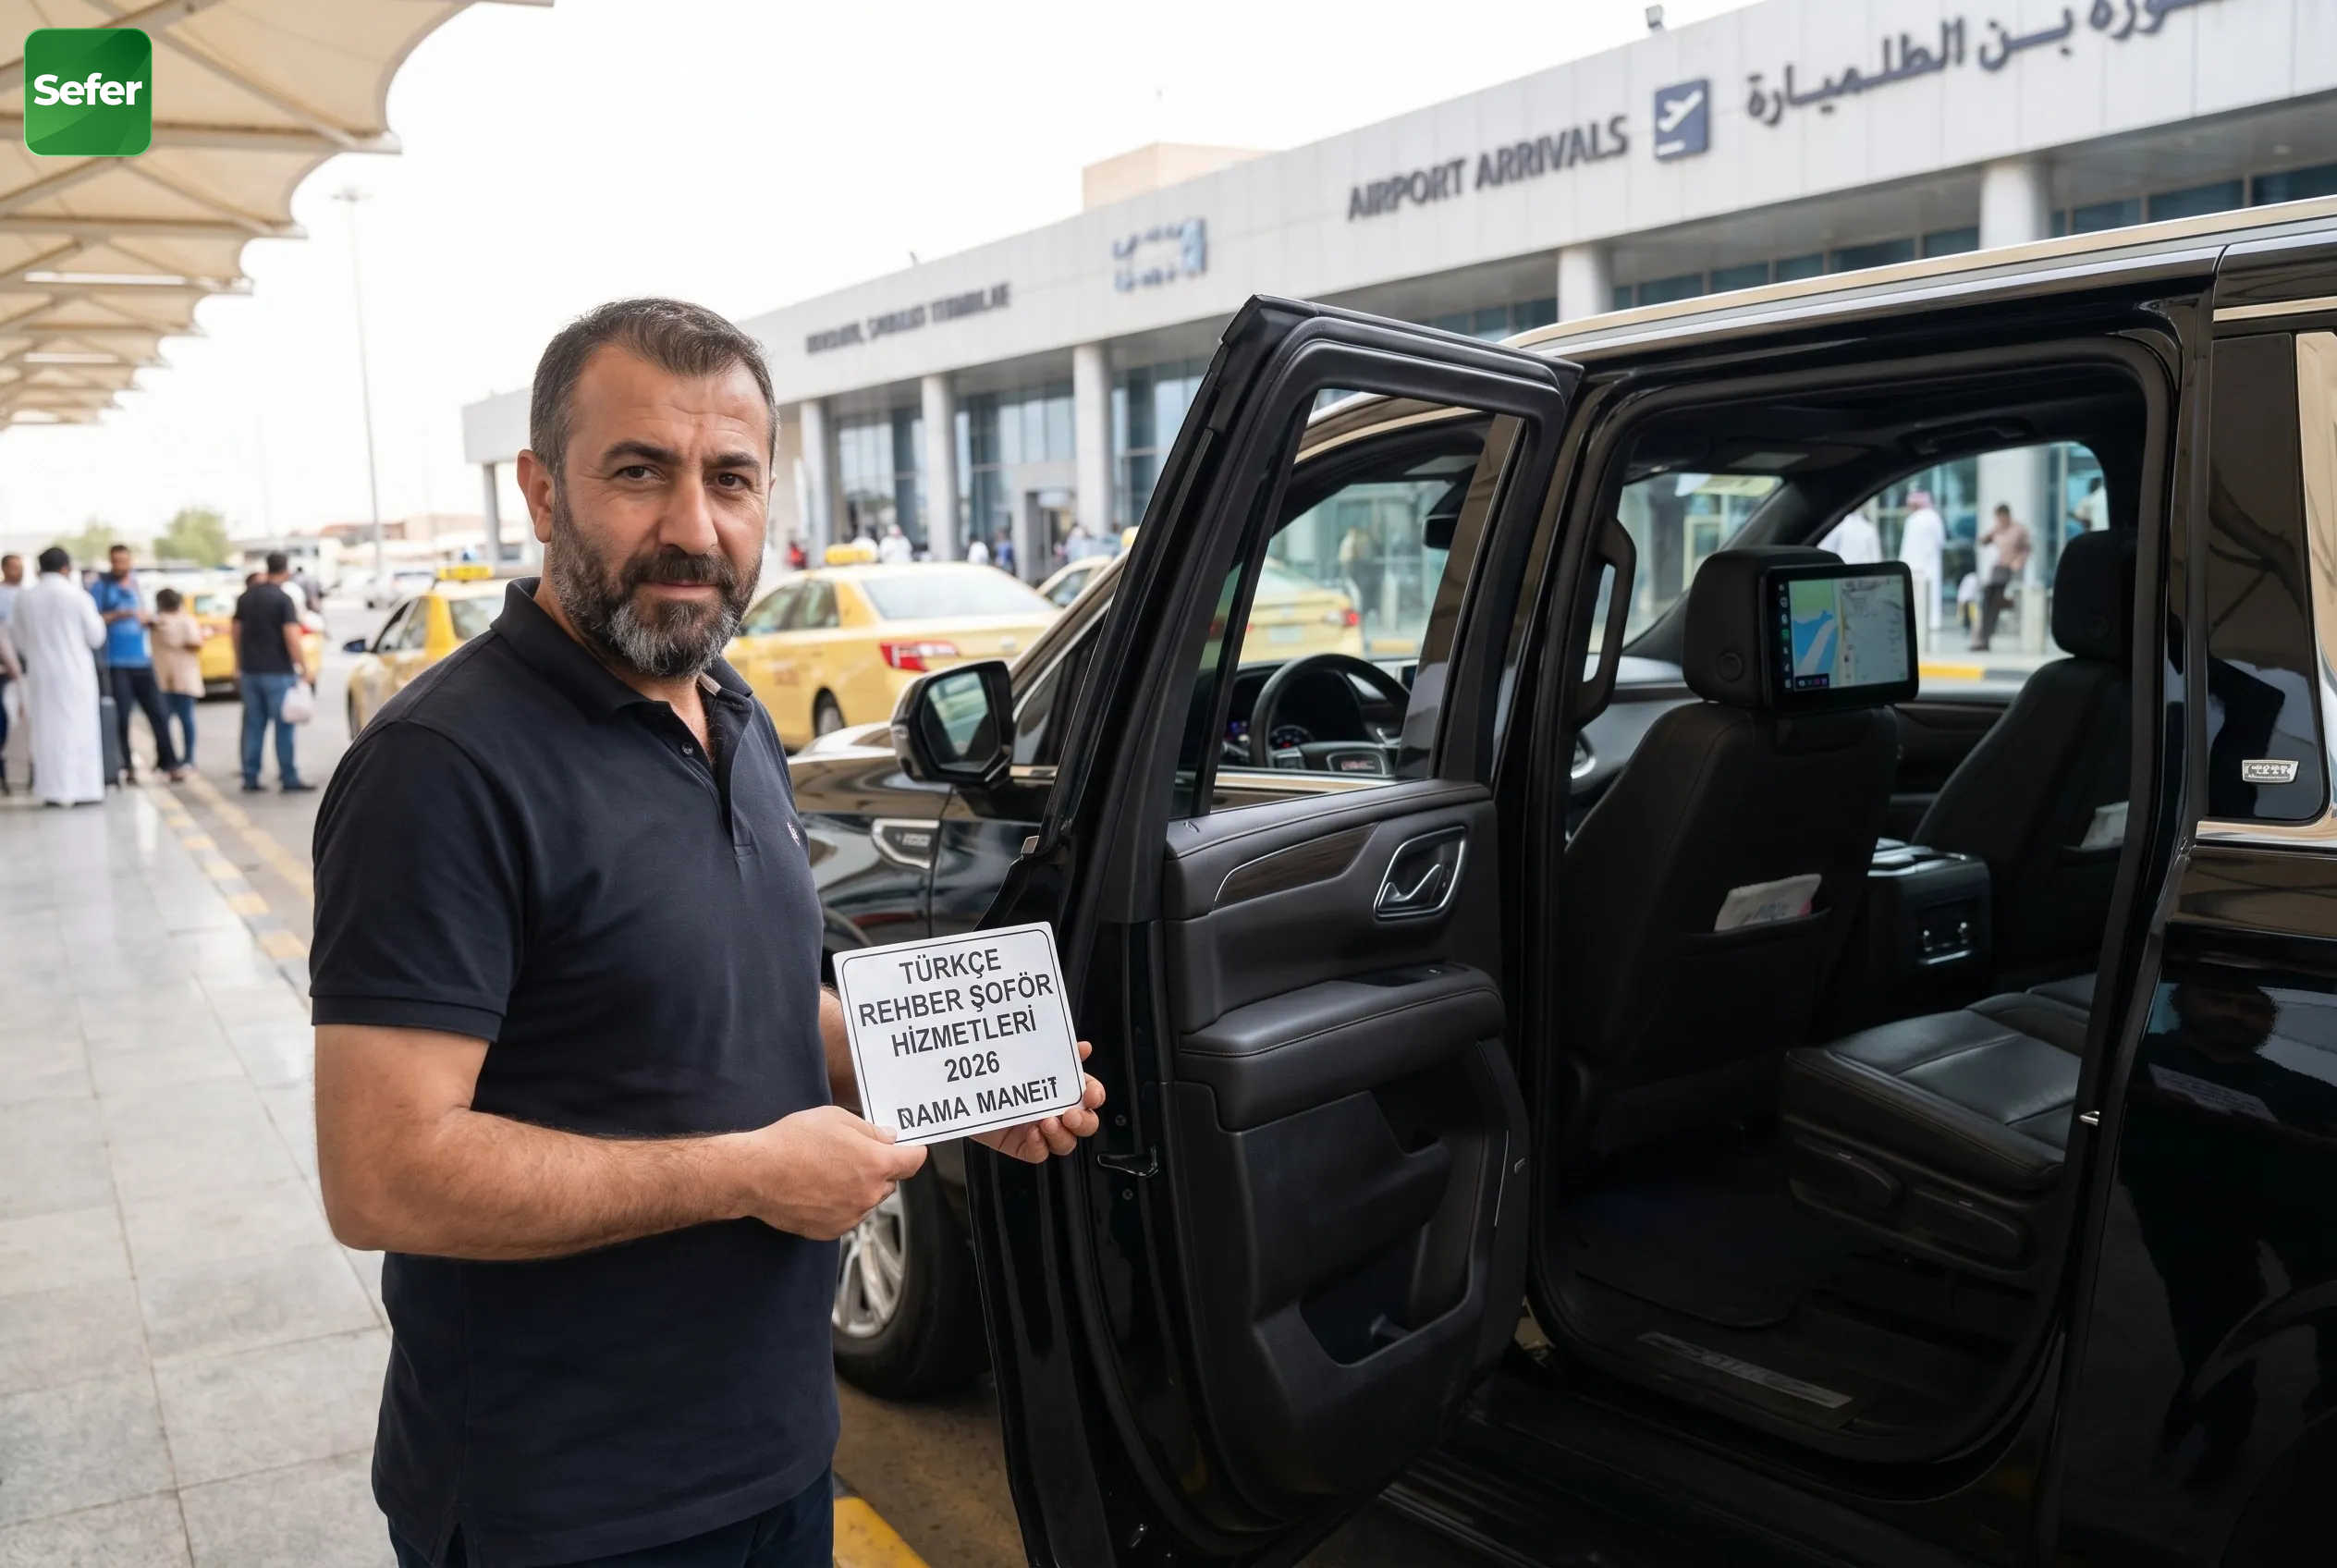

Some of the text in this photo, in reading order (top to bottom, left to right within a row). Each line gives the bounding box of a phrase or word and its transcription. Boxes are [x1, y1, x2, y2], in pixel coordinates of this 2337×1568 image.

[1348, 116, 1629, 220] AIRPORT ARRIVALS
[899, 948, 1001, 985] TÜRKÇE
[858, 972, 1054, 1027] REHBER ŞOFÖR
[891, 1004, 1037, 1057] HİZMETLERİ
[944, 1050, 1000, 1083] 2026
